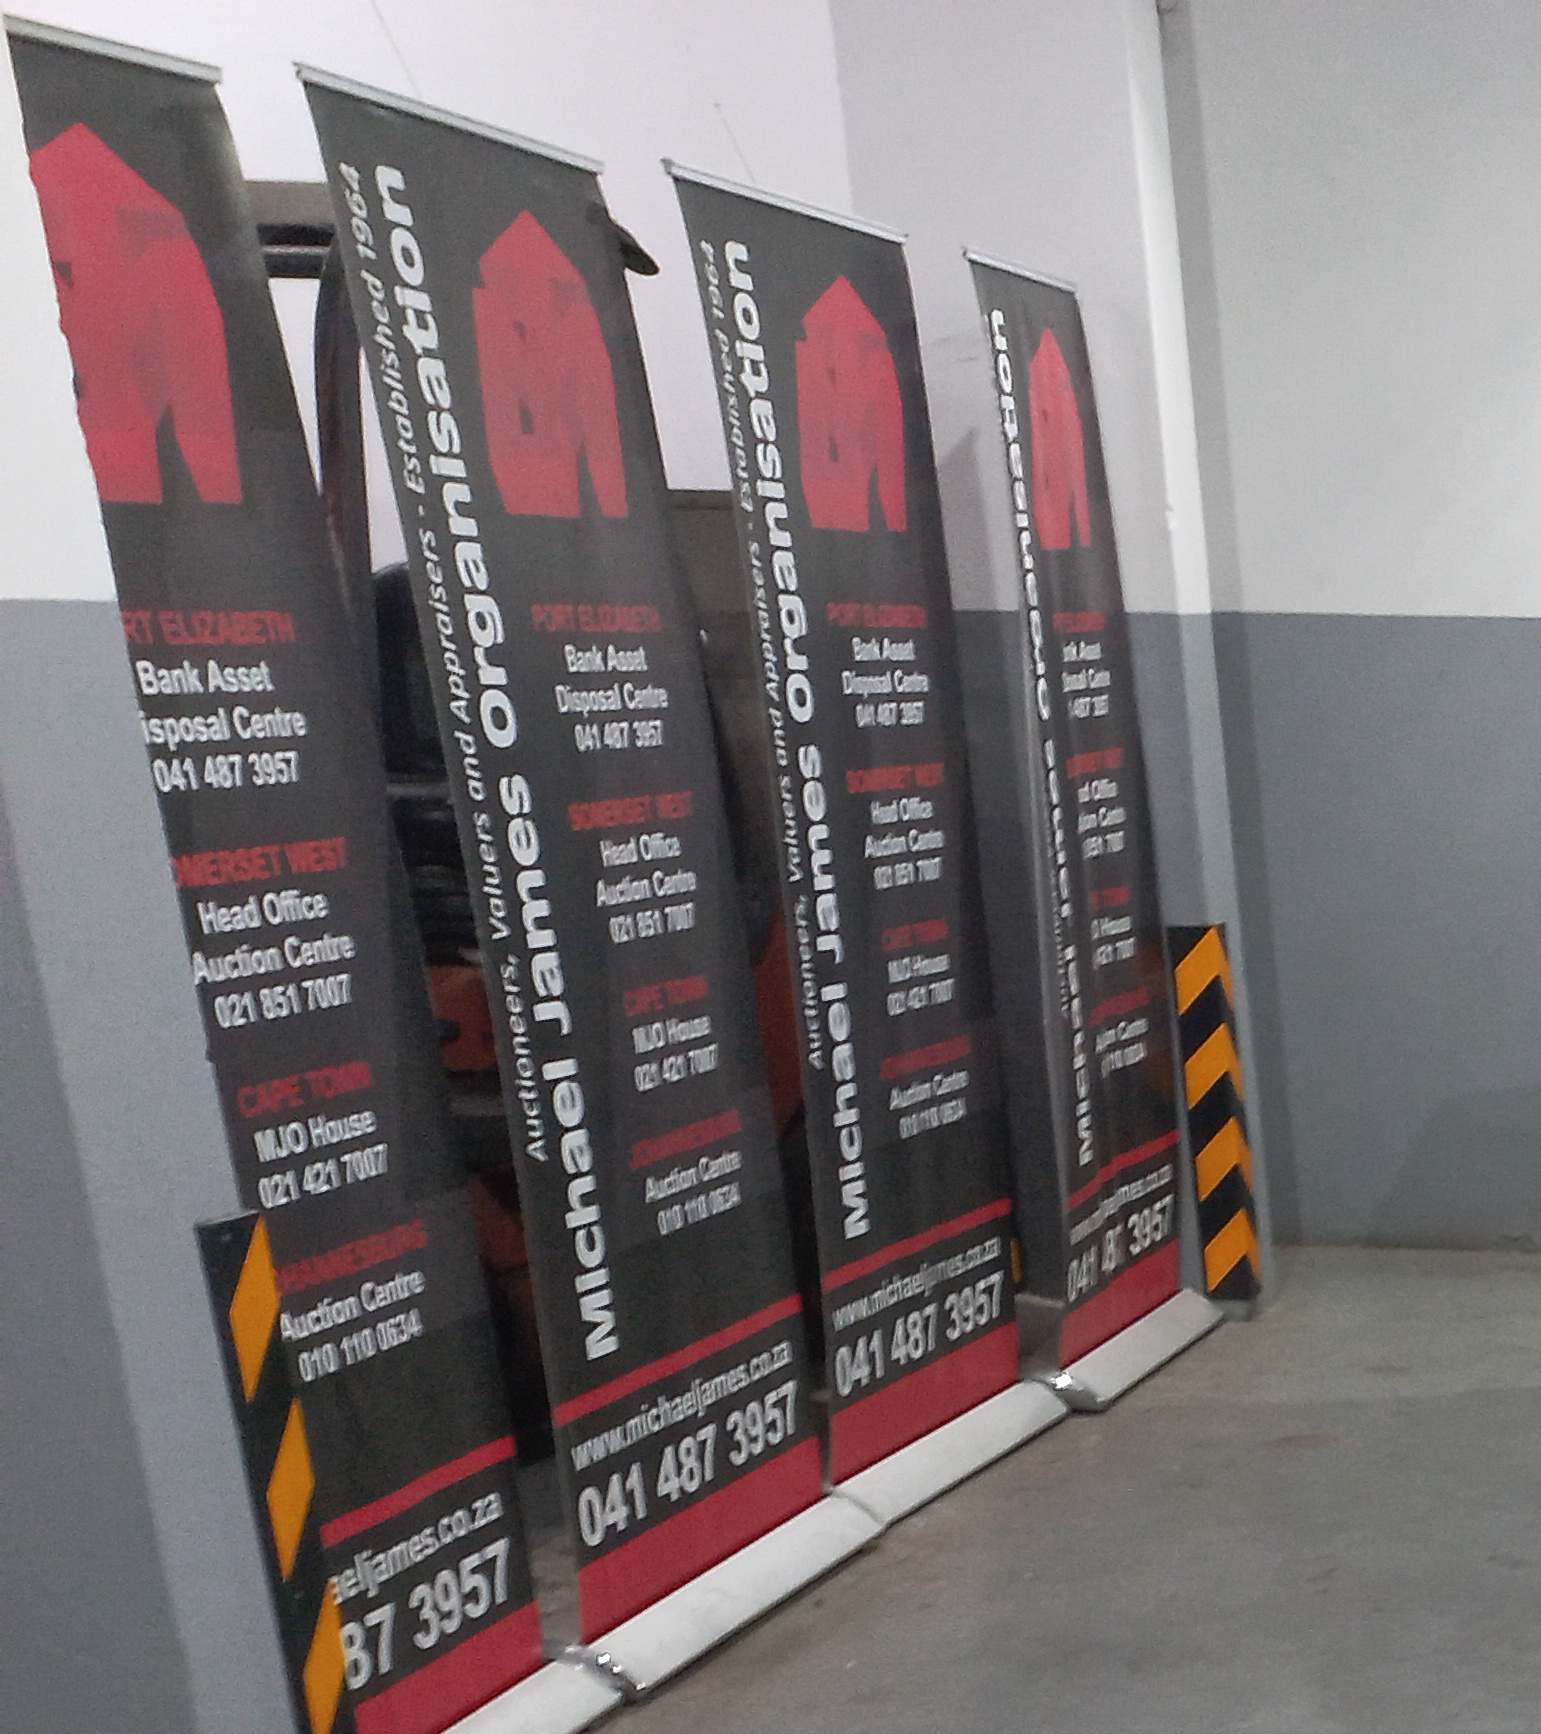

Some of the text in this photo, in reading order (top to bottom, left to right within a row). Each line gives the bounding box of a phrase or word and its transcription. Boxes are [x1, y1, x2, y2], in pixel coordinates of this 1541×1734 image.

[338, 161, 378, 262] 1964
[359, 269, 426, 494] Established
[160, 610, 297, 645] ELIZABETH
[418, 527, 472, 725] Appraisers
[749, 541, 780, 702] Appraisers
[136, 659, 275, 695] Bank Asset
[564, 644, 648, 673] Bank Asset
[139, 705, 307, 751] isposal Centre
[555, 681, 669, 718] Disposal Centre
[374, 165, 620, 1361] Michael James Organisation
[453, 729, 487, 802] and
[574, 723, 601, 753] 041
[724, 240, 871, 1240] Michael James Organisation
[768, 706, 788, 767] and
[152, 750, 299, 792] 041 487 3957
[472, 810, 513, 940] Valuers
[599, 832, 682, 868] Head Office
[197, 889, 328, 934] Head Office
[596, 868, 697, 907] Auction Centre
[193, 934, 355, 985] Auction Centre
[214, 973, 352, 1028] 021 851 7007
[500, 952, 550, 1163] Auctioneers,
[254, 1110, 378, 1162] MJO House
[258, 1143, 388, 1209] 021 421 7007
[645, 1149, 742, 1203] Auction Centre
[1127, 1193, 1175, 1256] 3957
[280, 1270, 426, 1343] Auction Centre
[835, 1270, 1004, 1398] 041 487 3957
[298, 1342, 340, 1383] 010
[340, 1327, 378, 1365] 110
[571, 1339, 793, 1472] www.michaeljames.co.za
[577, 1379, 798, 1547] 041 487 3957
[340, 1537, 510, 1691] 87 3957
